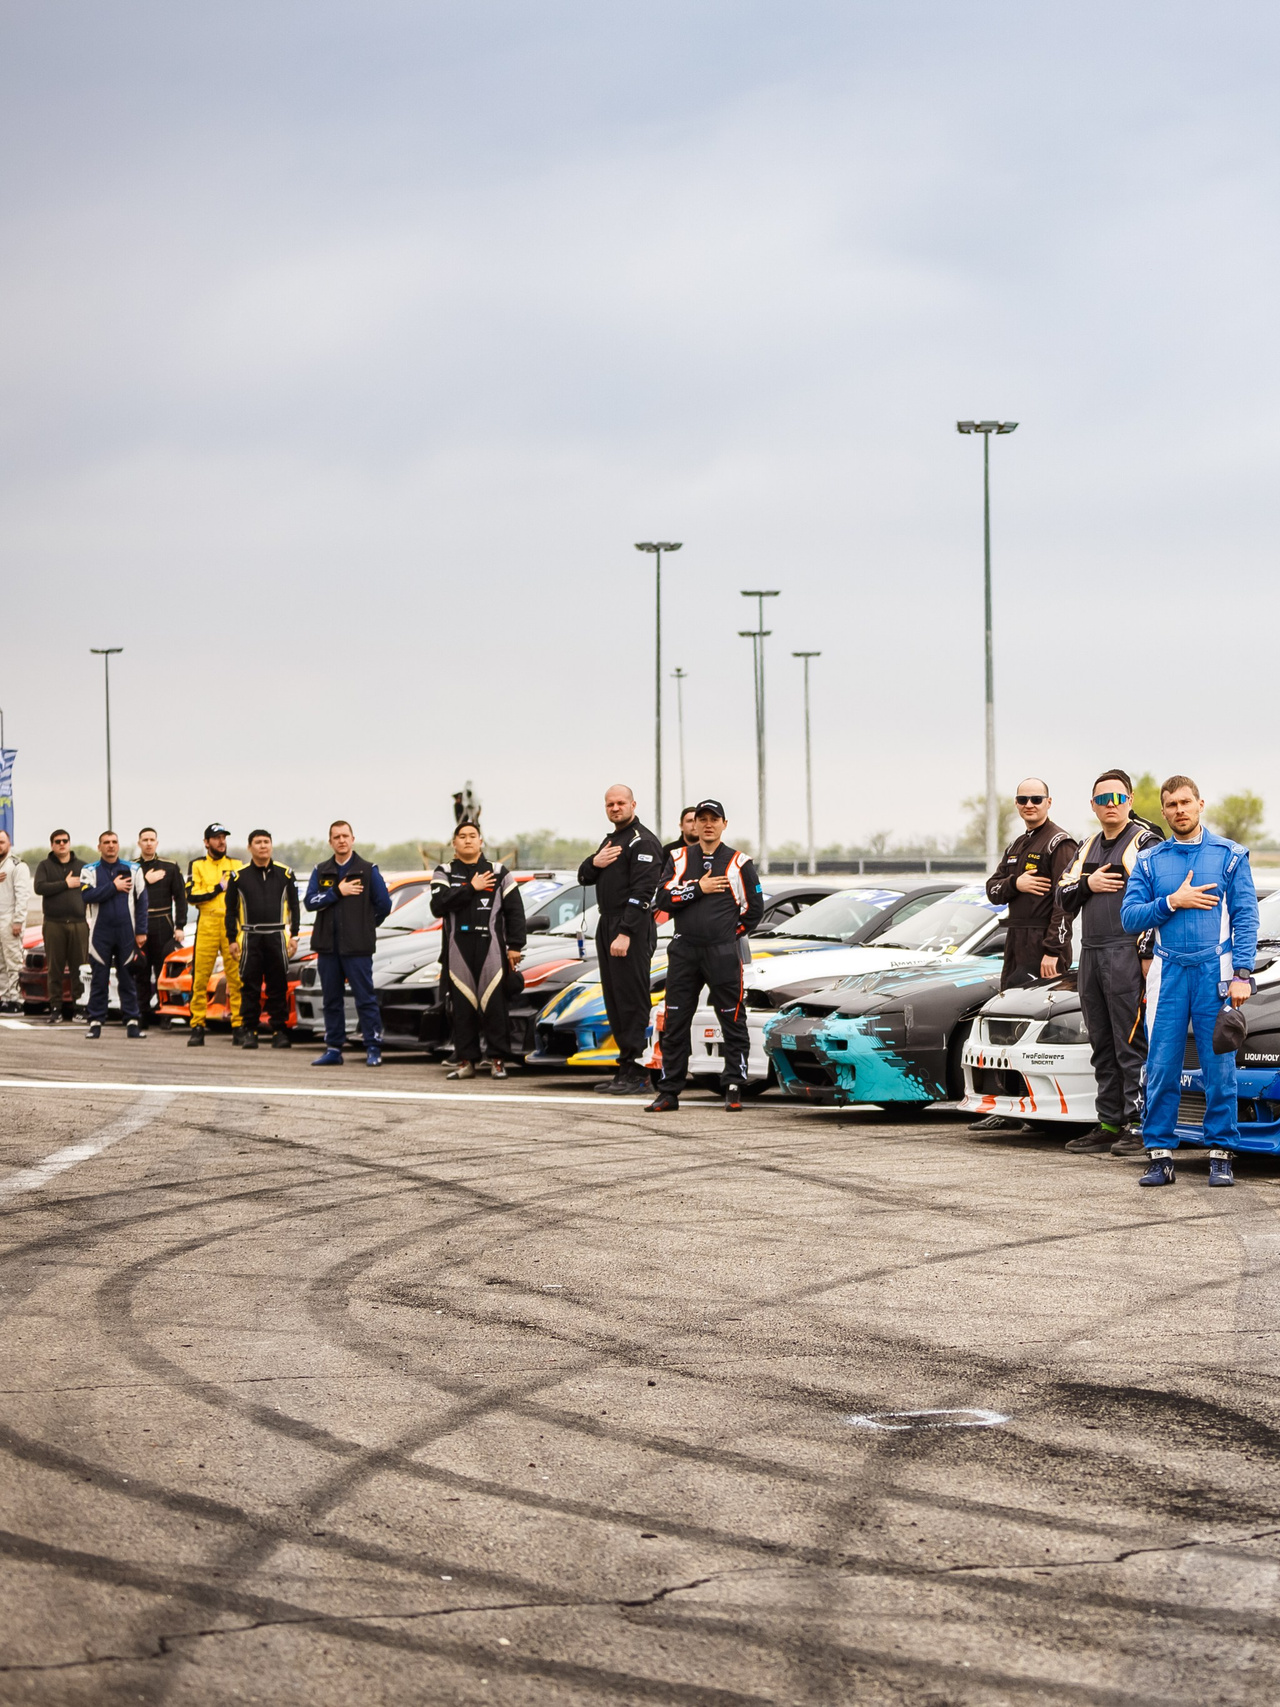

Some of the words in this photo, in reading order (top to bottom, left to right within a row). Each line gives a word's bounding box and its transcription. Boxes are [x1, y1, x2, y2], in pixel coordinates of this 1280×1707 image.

[1022, 1052, 1065, 1060] TwoFollowers
[1244, 1053, 1261, 1061] LIQUI
[1262, 1054, 1280, 1062] MOLY
[1180, 1074, 1193, 1087] APY
